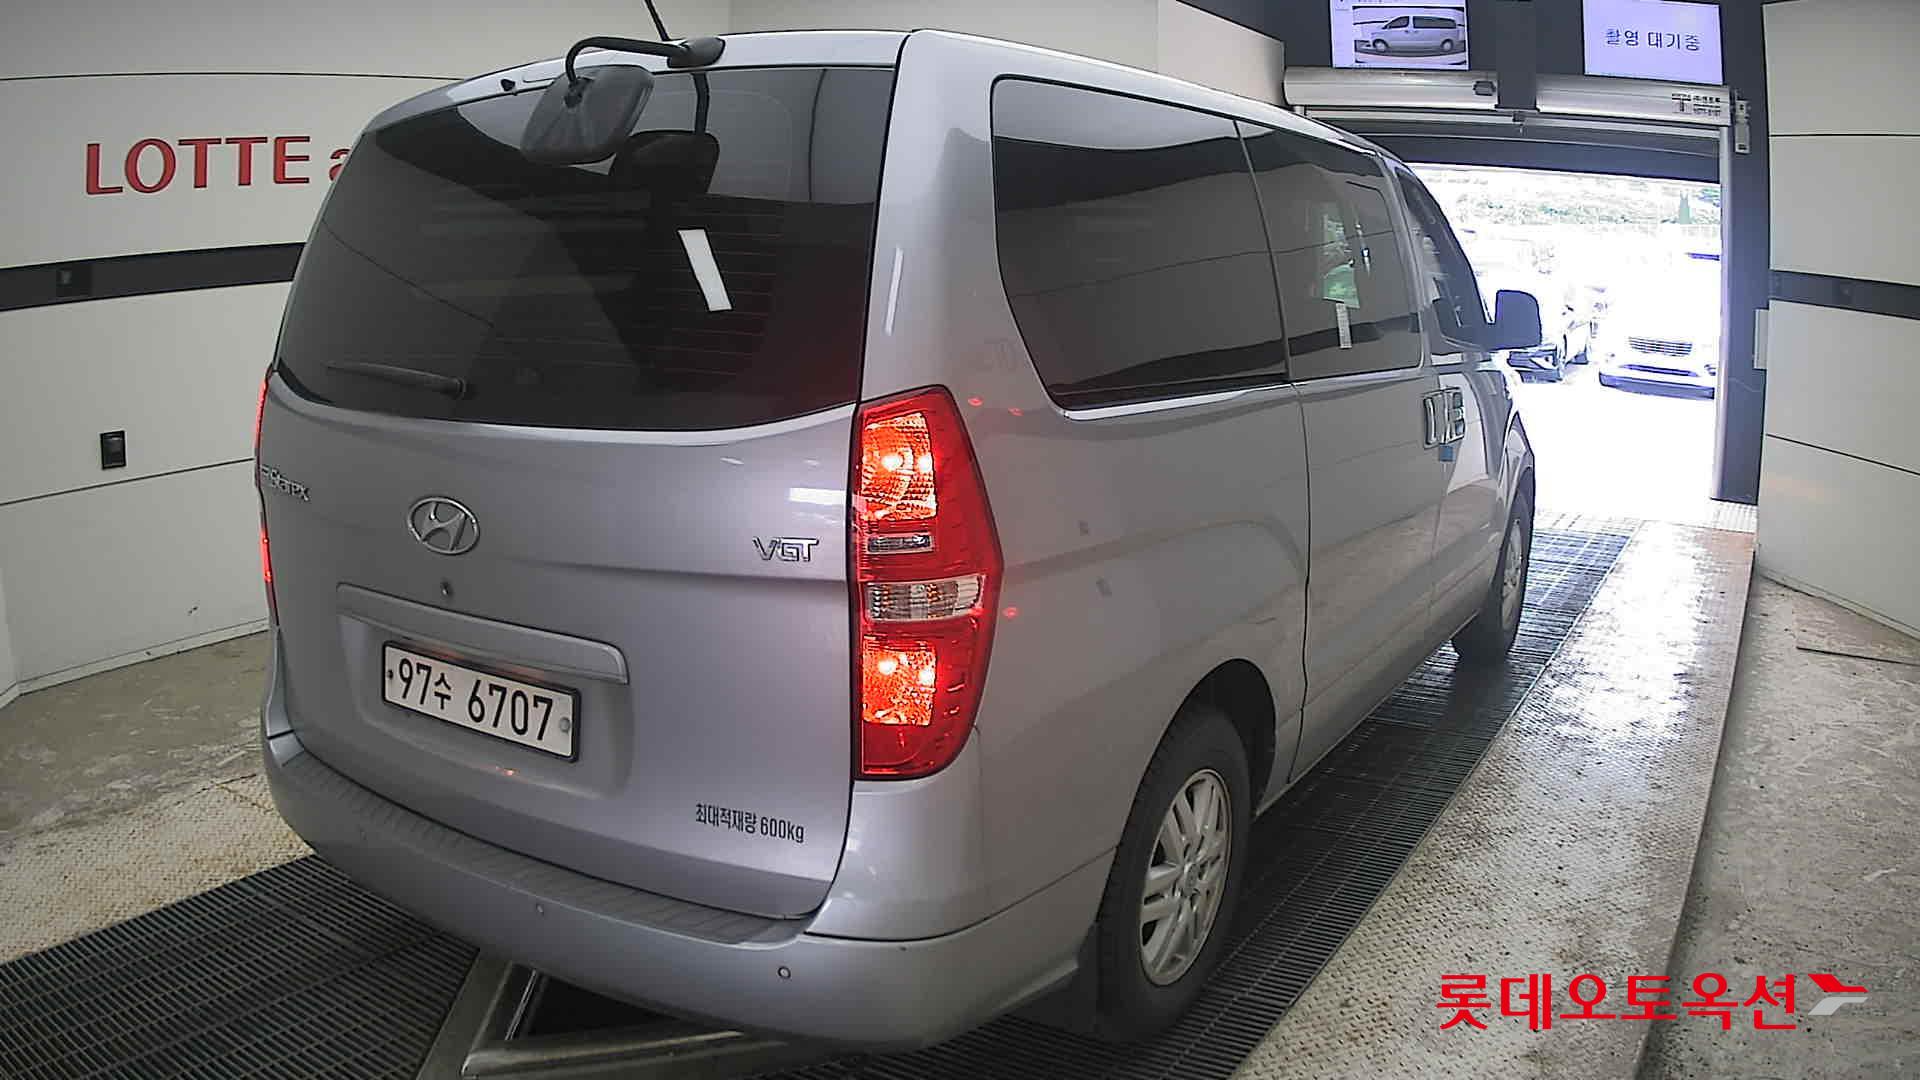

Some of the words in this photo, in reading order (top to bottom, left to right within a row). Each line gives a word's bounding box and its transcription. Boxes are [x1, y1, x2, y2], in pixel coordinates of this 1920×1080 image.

[1647, 31, 1700, 52] 대기중
[85, 135, 311, 196] LOTTE
[752, 536, 820, 562] VGT
[399, 658, 452, 710] 97수
[467, 679, 554, 741] 6707
[695, 803, 757, 834] 최대적재량
[760, 816, 804, 844] 600kg
